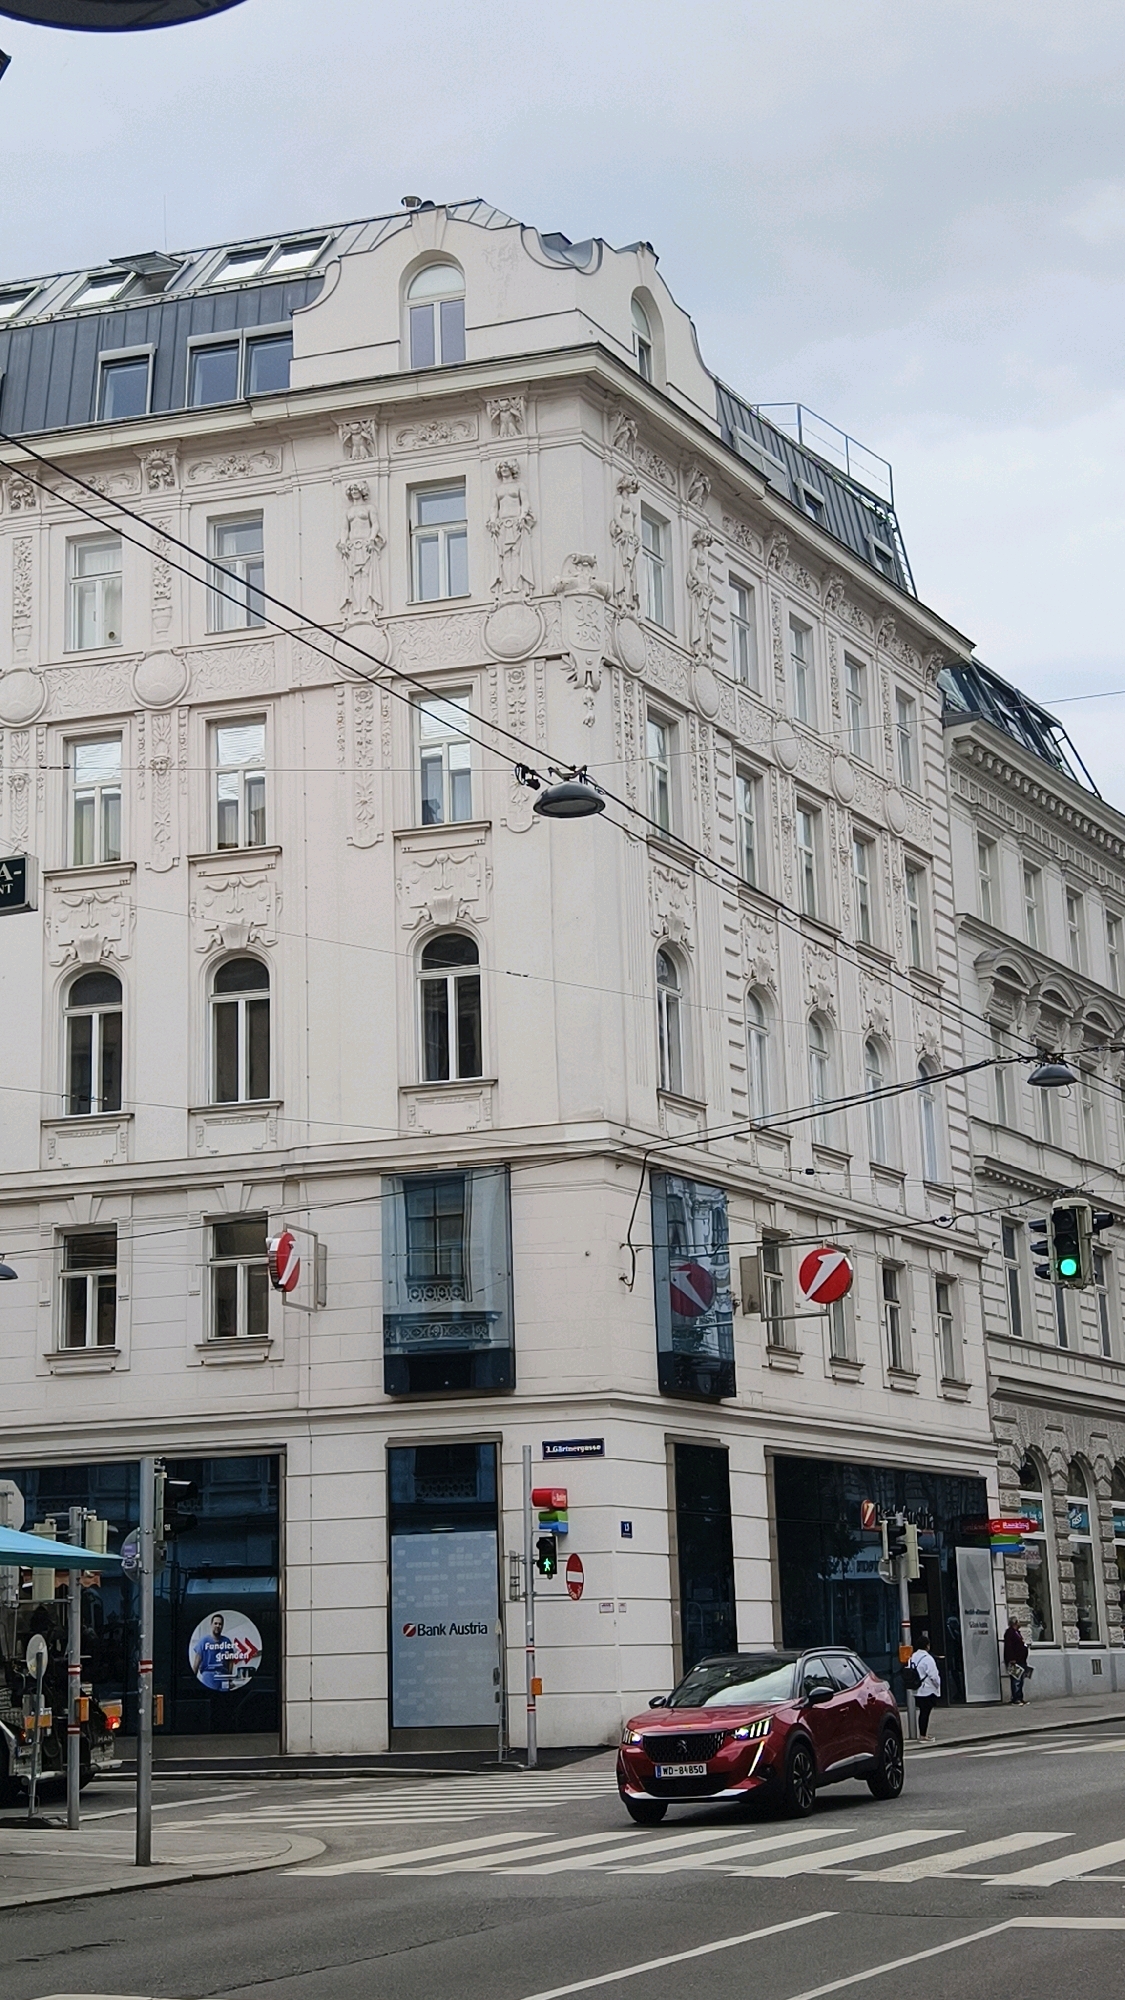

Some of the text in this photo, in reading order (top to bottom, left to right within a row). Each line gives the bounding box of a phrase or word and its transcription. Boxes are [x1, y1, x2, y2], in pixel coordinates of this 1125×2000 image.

[1002, 1521, 1030, 1531] Banking
[417, 1622, 488, 1637] Bank Austria
[204, 1642, 240, 1651] Fundiert
[215, 1651, 250, 1663] gründen
